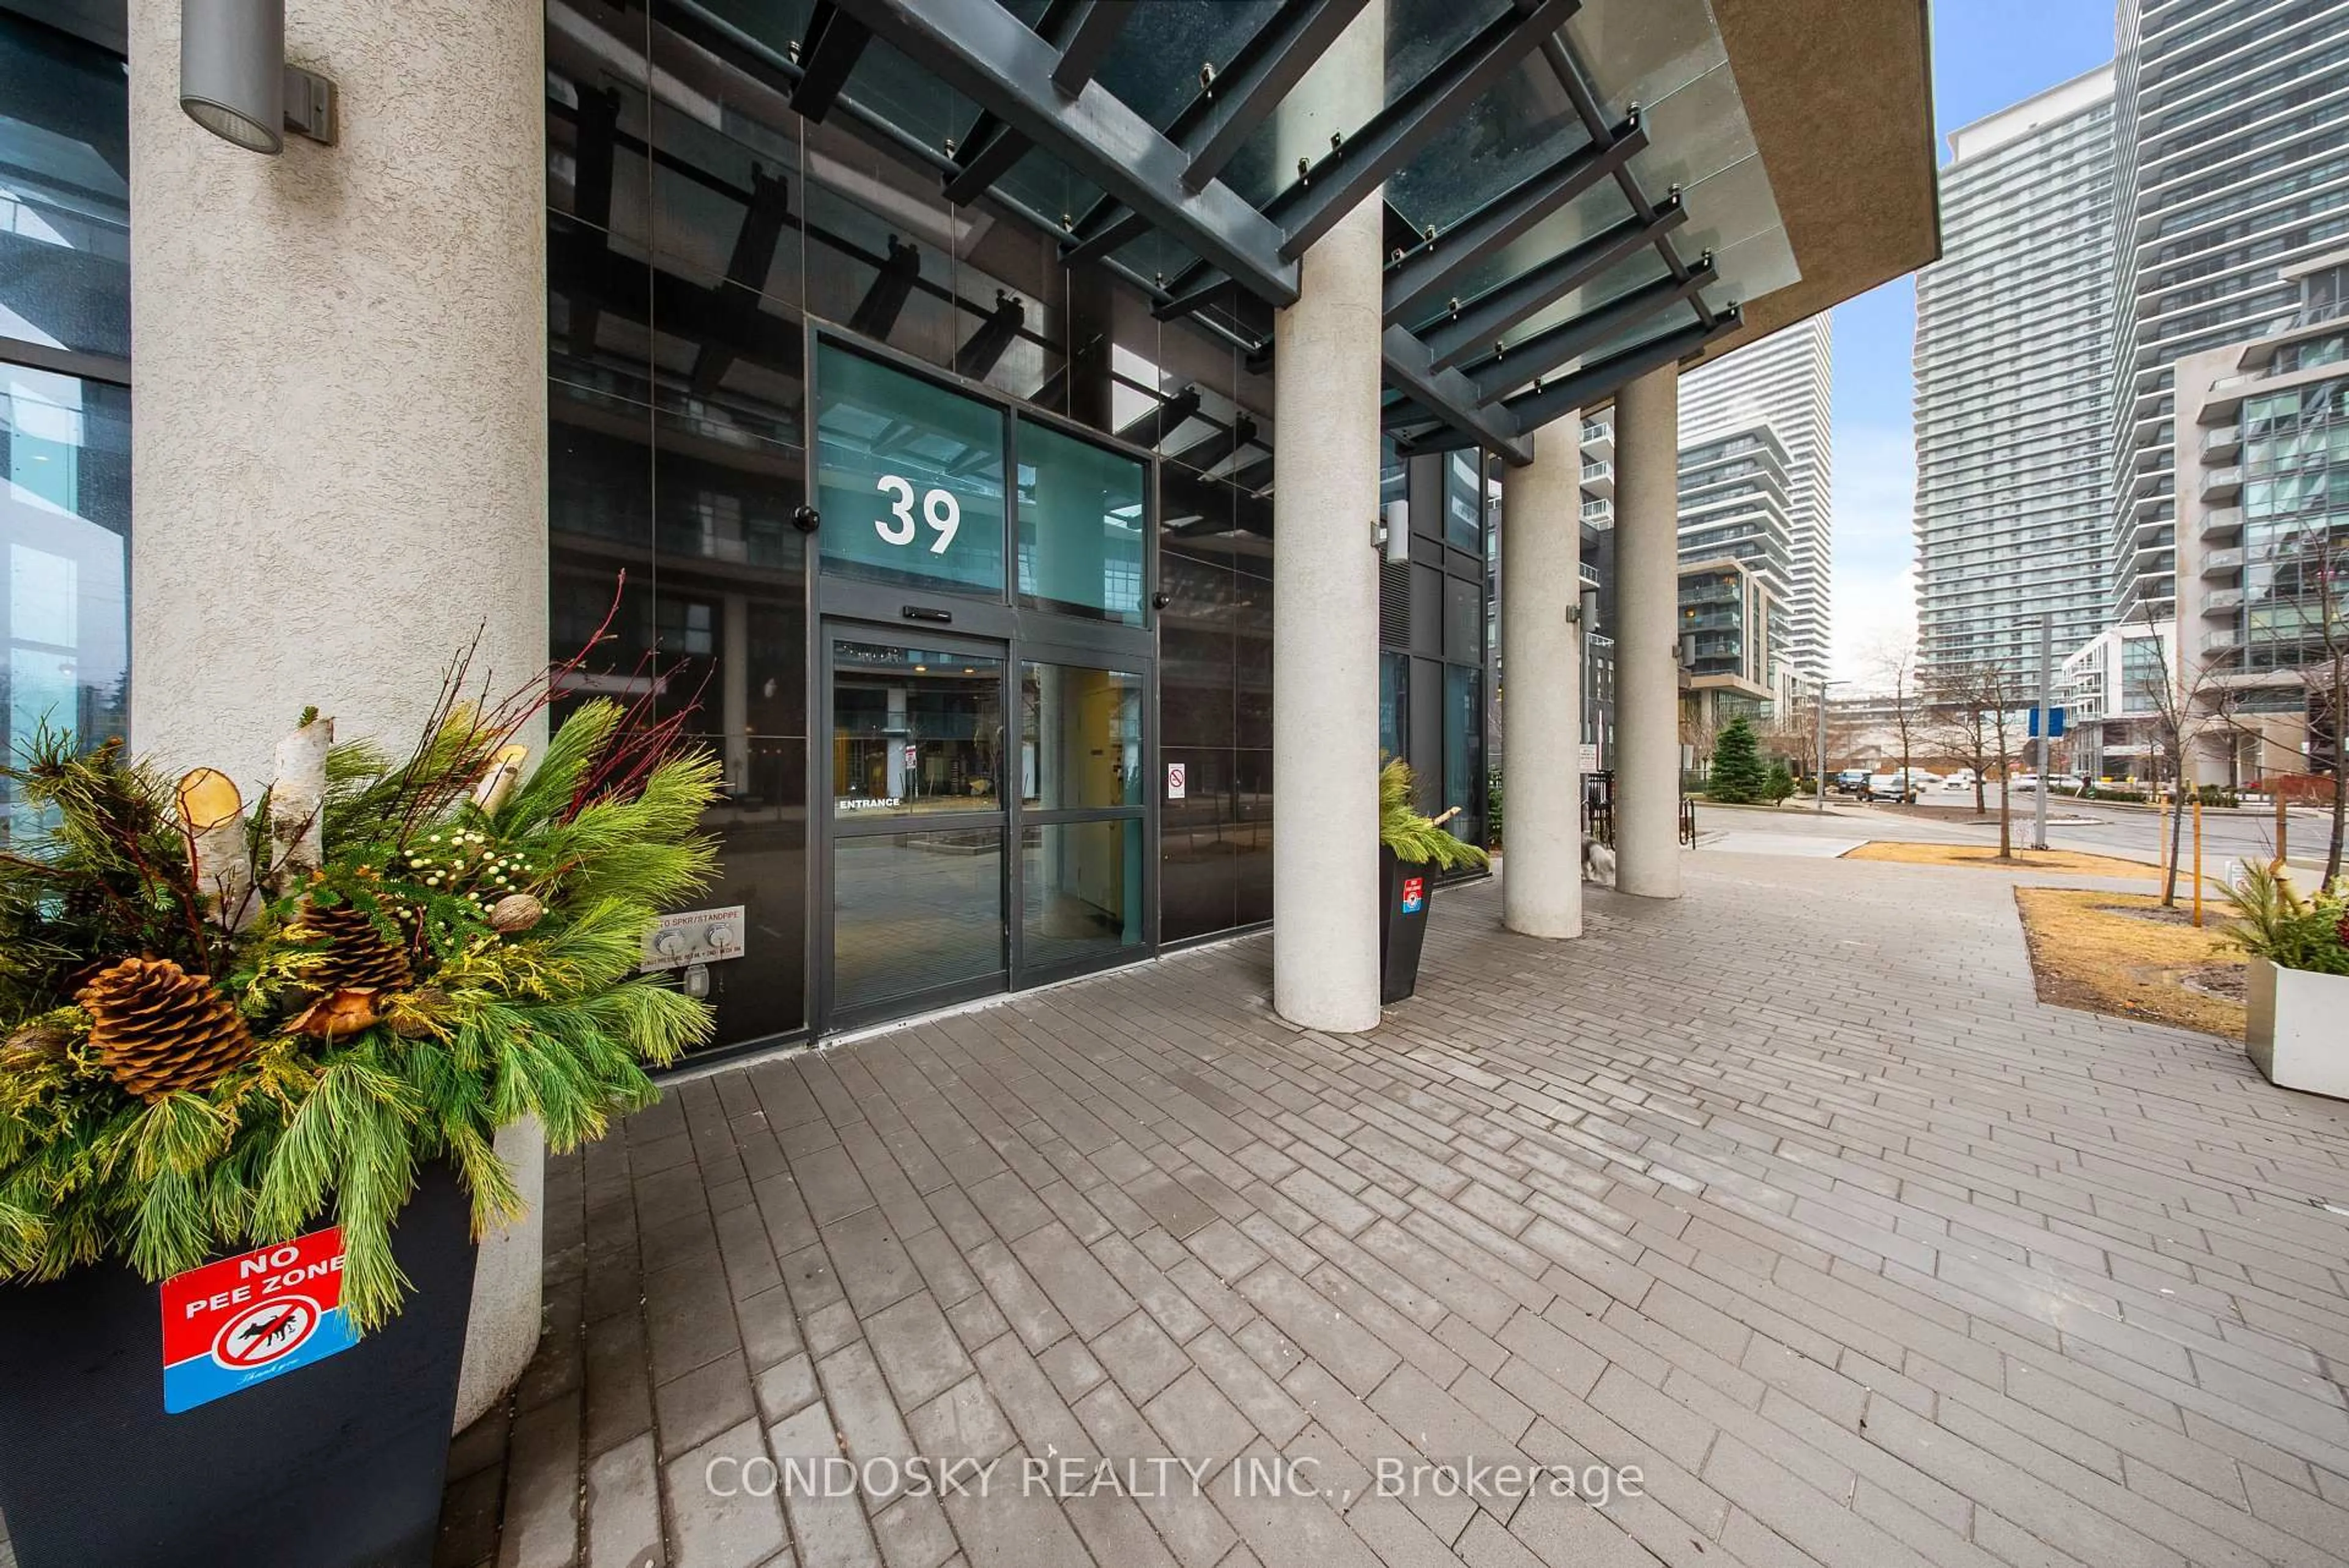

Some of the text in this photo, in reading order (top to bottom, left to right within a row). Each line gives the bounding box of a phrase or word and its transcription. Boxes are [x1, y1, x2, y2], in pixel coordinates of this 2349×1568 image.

[875, 475, 960, 553] 39
[840, 798, 900, 809] ENTRANCE
[186, 1254, 346, 1319] PEE ZONE
[240, 1246, 300, 1279] NO
